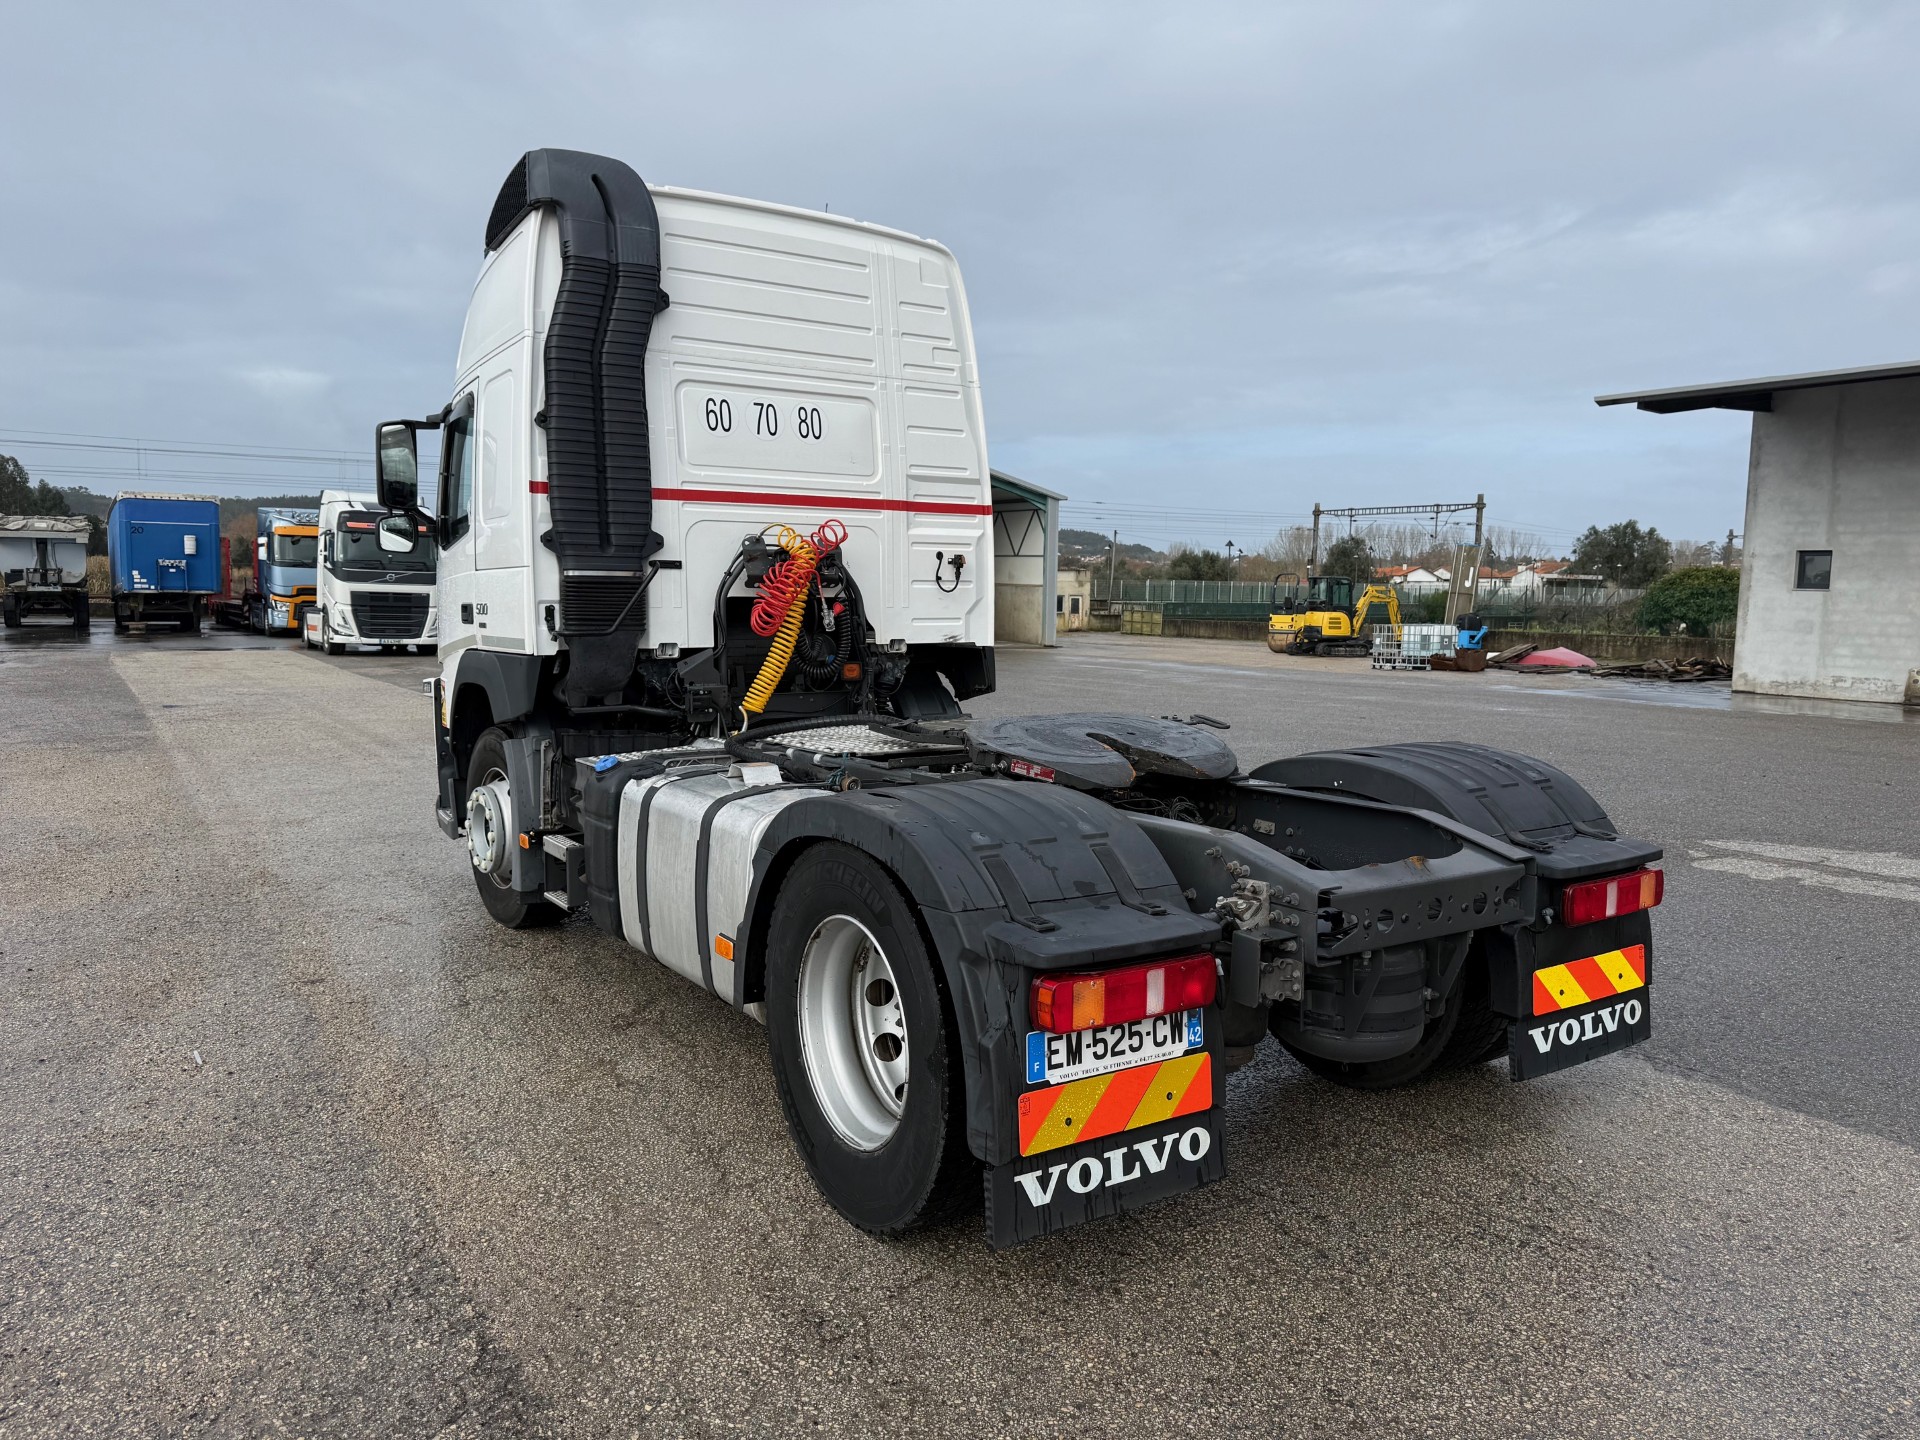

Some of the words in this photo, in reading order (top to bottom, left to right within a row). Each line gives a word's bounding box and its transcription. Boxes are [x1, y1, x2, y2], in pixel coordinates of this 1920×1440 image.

[705, 397, 732, 433] 60
[753, 402, 778, 437] 70
[797, 406, 822, 440] 80
[131, 526, 144, 534] 20
[476, 603, 488, 615] 500
[1189, 1026, 1202, 1043] 42
[1528, 999, 1642, 1053] VOLVO
[1047, 1012, 1183, 1070] EM-525-CW
[1033, 1062, 1041, 1073] F
[1059, 1071, 1079, 1080] VOLVO
[1082, 1067, 1100, 1075] TRUCK
[1014, 1126, 1211, 1208] VOLVO
